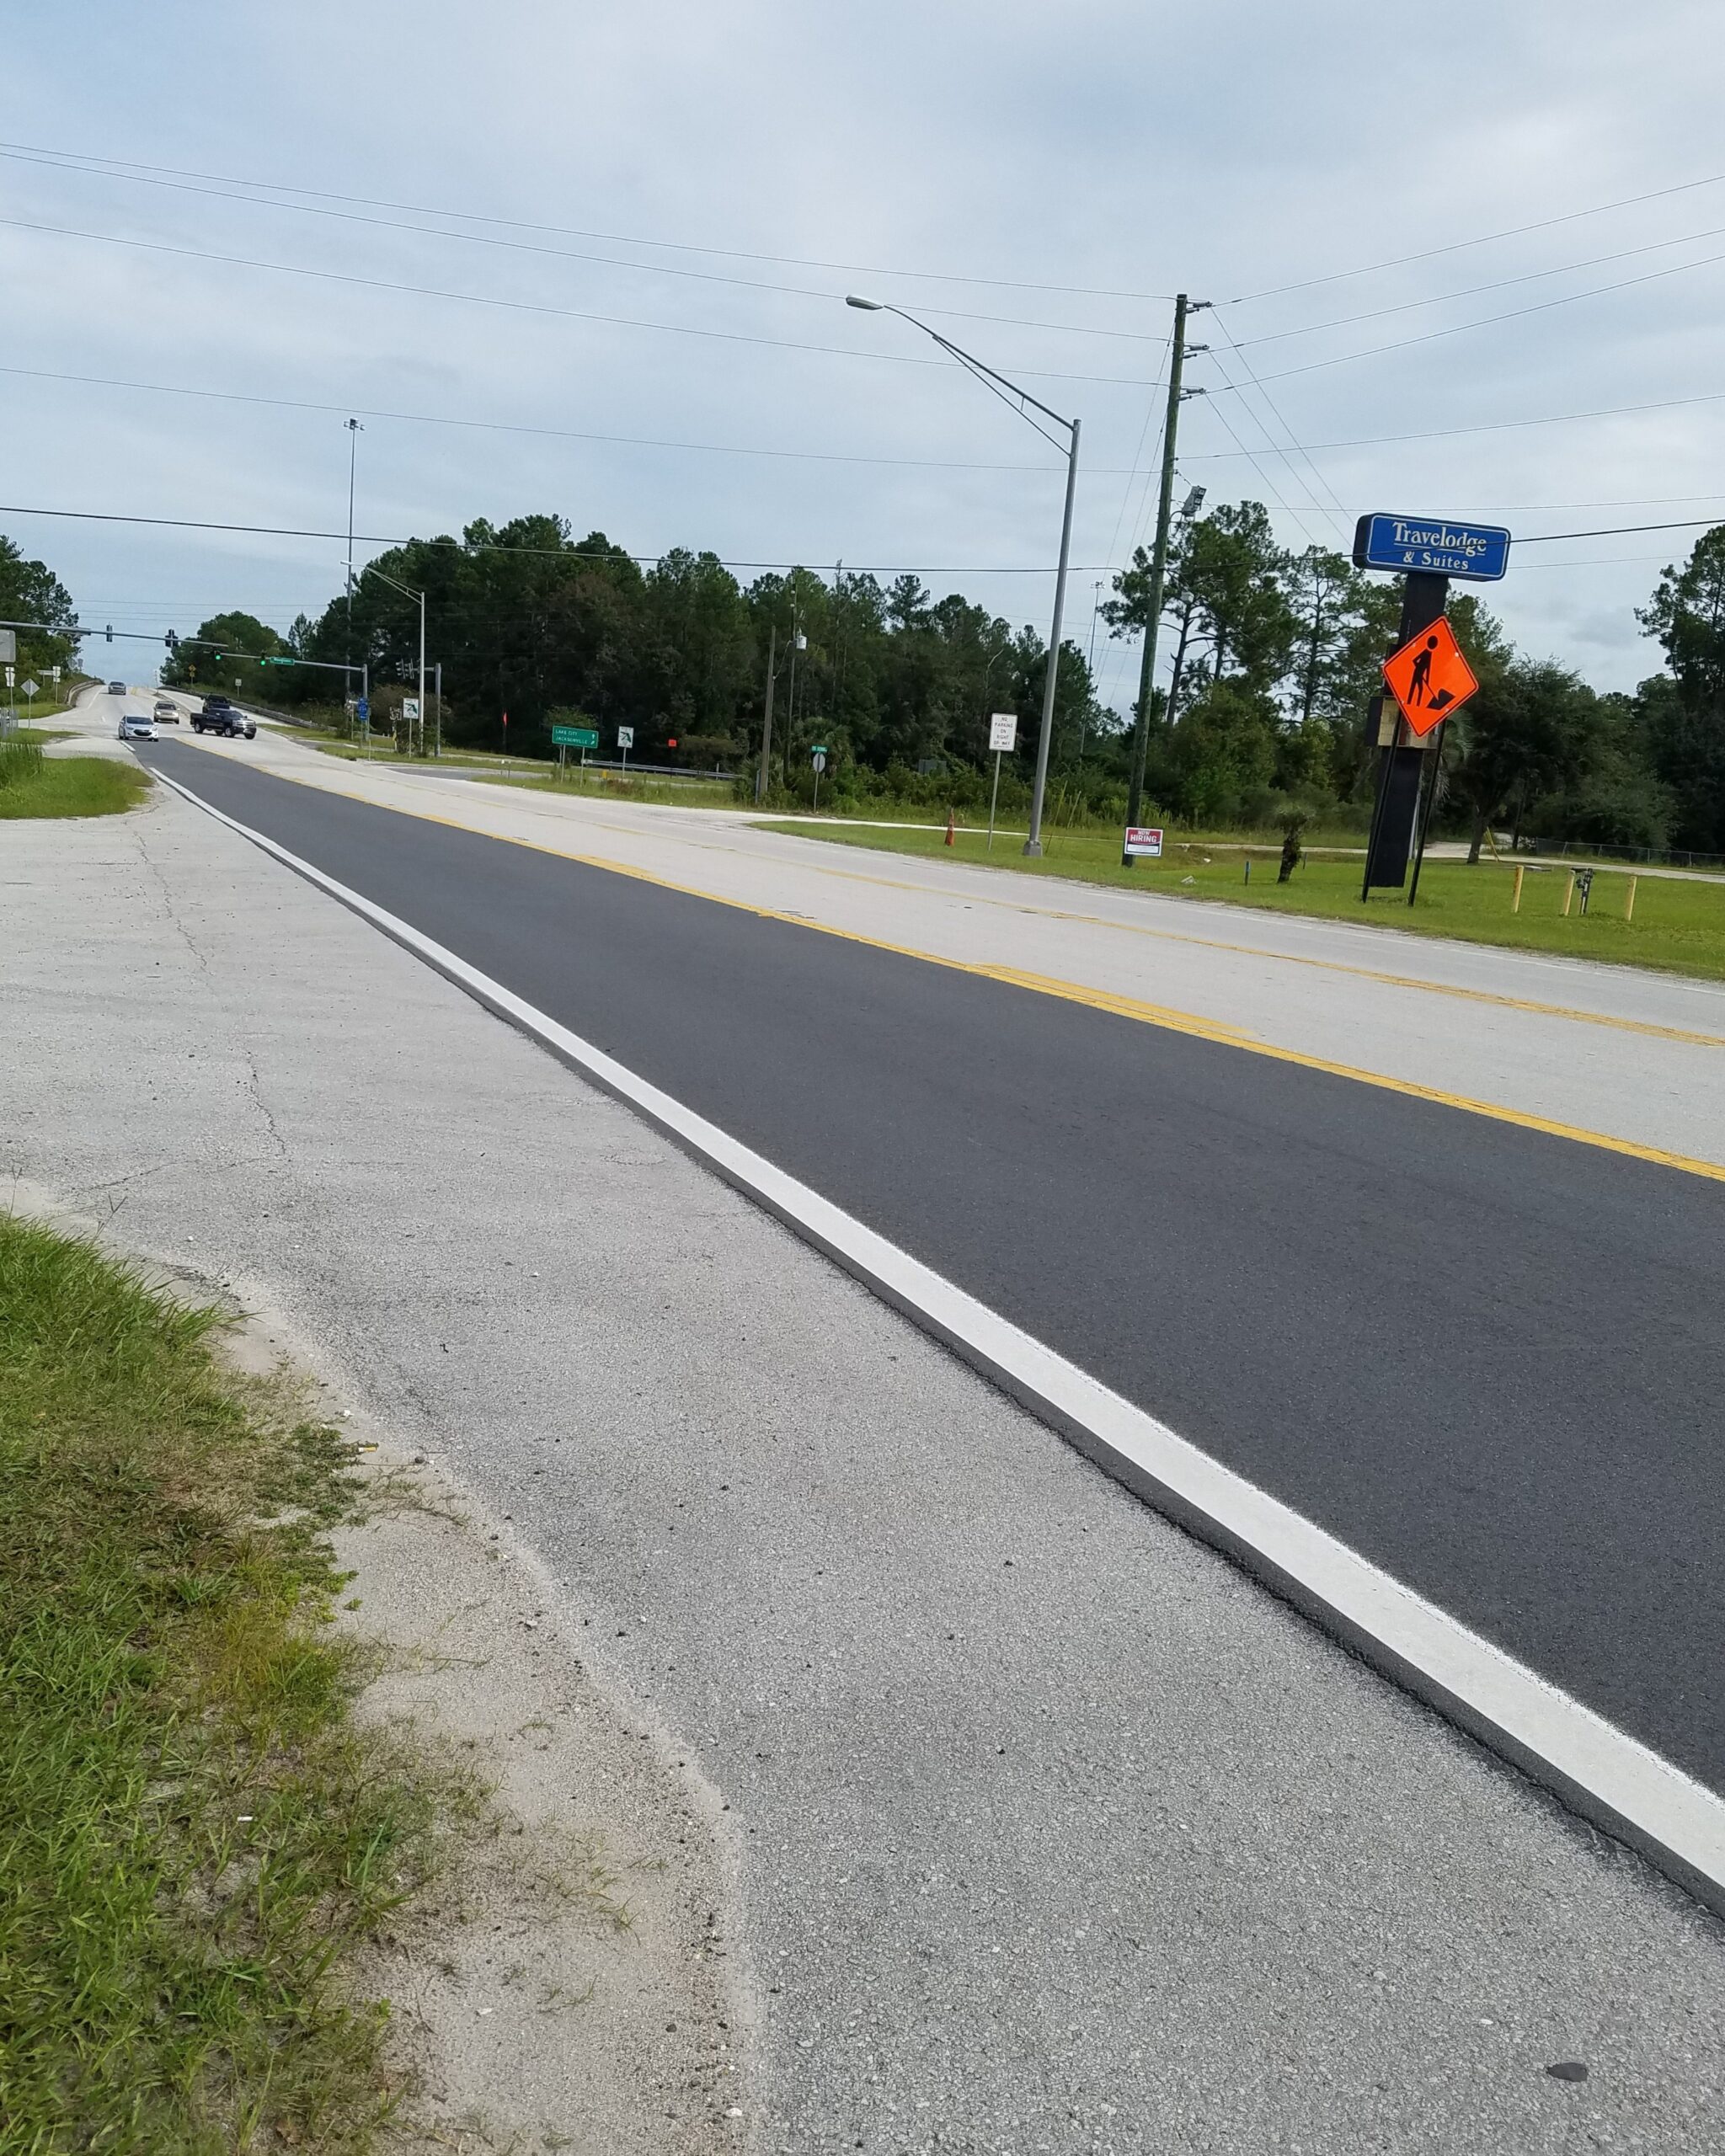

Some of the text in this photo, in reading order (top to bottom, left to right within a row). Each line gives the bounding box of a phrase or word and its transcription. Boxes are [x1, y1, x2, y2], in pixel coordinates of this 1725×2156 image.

[1392, 521, 1487, 557] Travelodge
[1402, 551, 1469, 570] & Suites
[1130, 834, 1158, 843] HIRING
